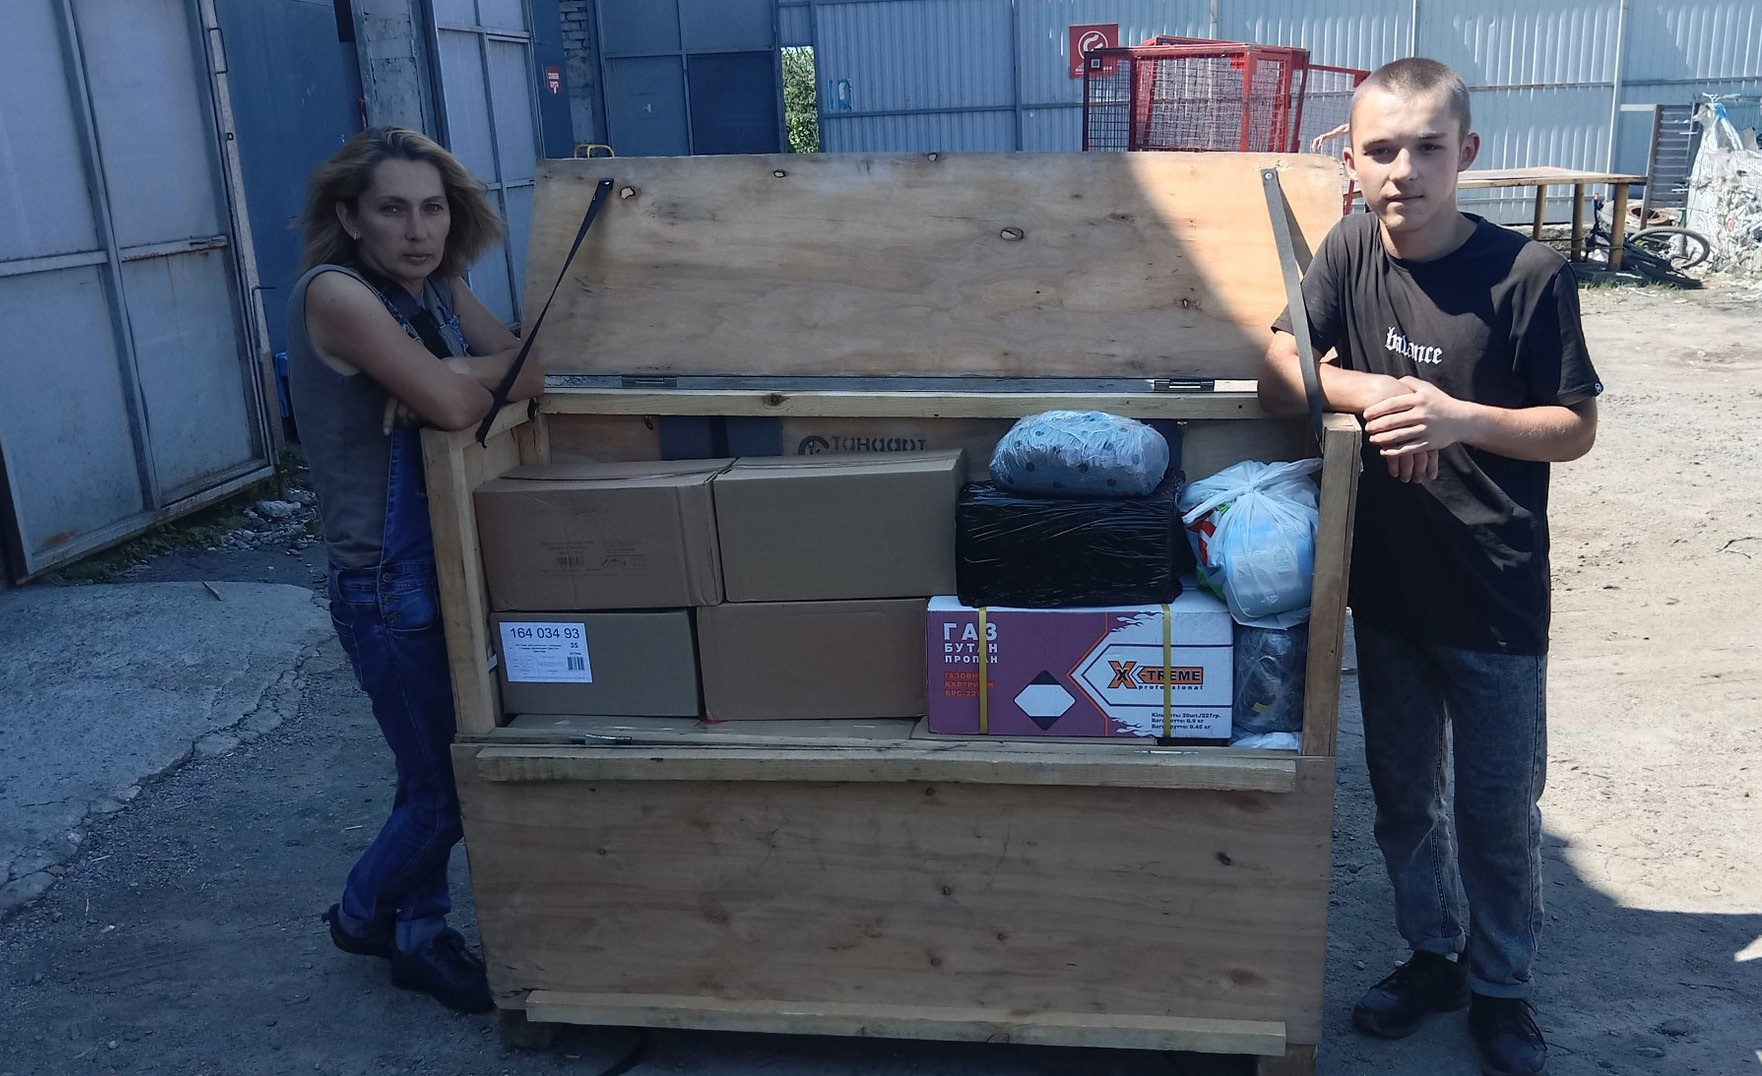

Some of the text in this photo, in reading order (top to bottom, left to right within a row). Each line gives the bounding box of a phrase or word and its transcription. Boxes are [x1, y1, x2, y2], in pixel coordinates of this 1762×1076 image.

[1385, 326, 1443, 365] balance
[509, 627, 580, 639] 164 034 93
[943, 622, 998, 641] ГАЗ
[944, 643, 998, 653] БУТН
[945, 655, 998, 663] ПРОПН
